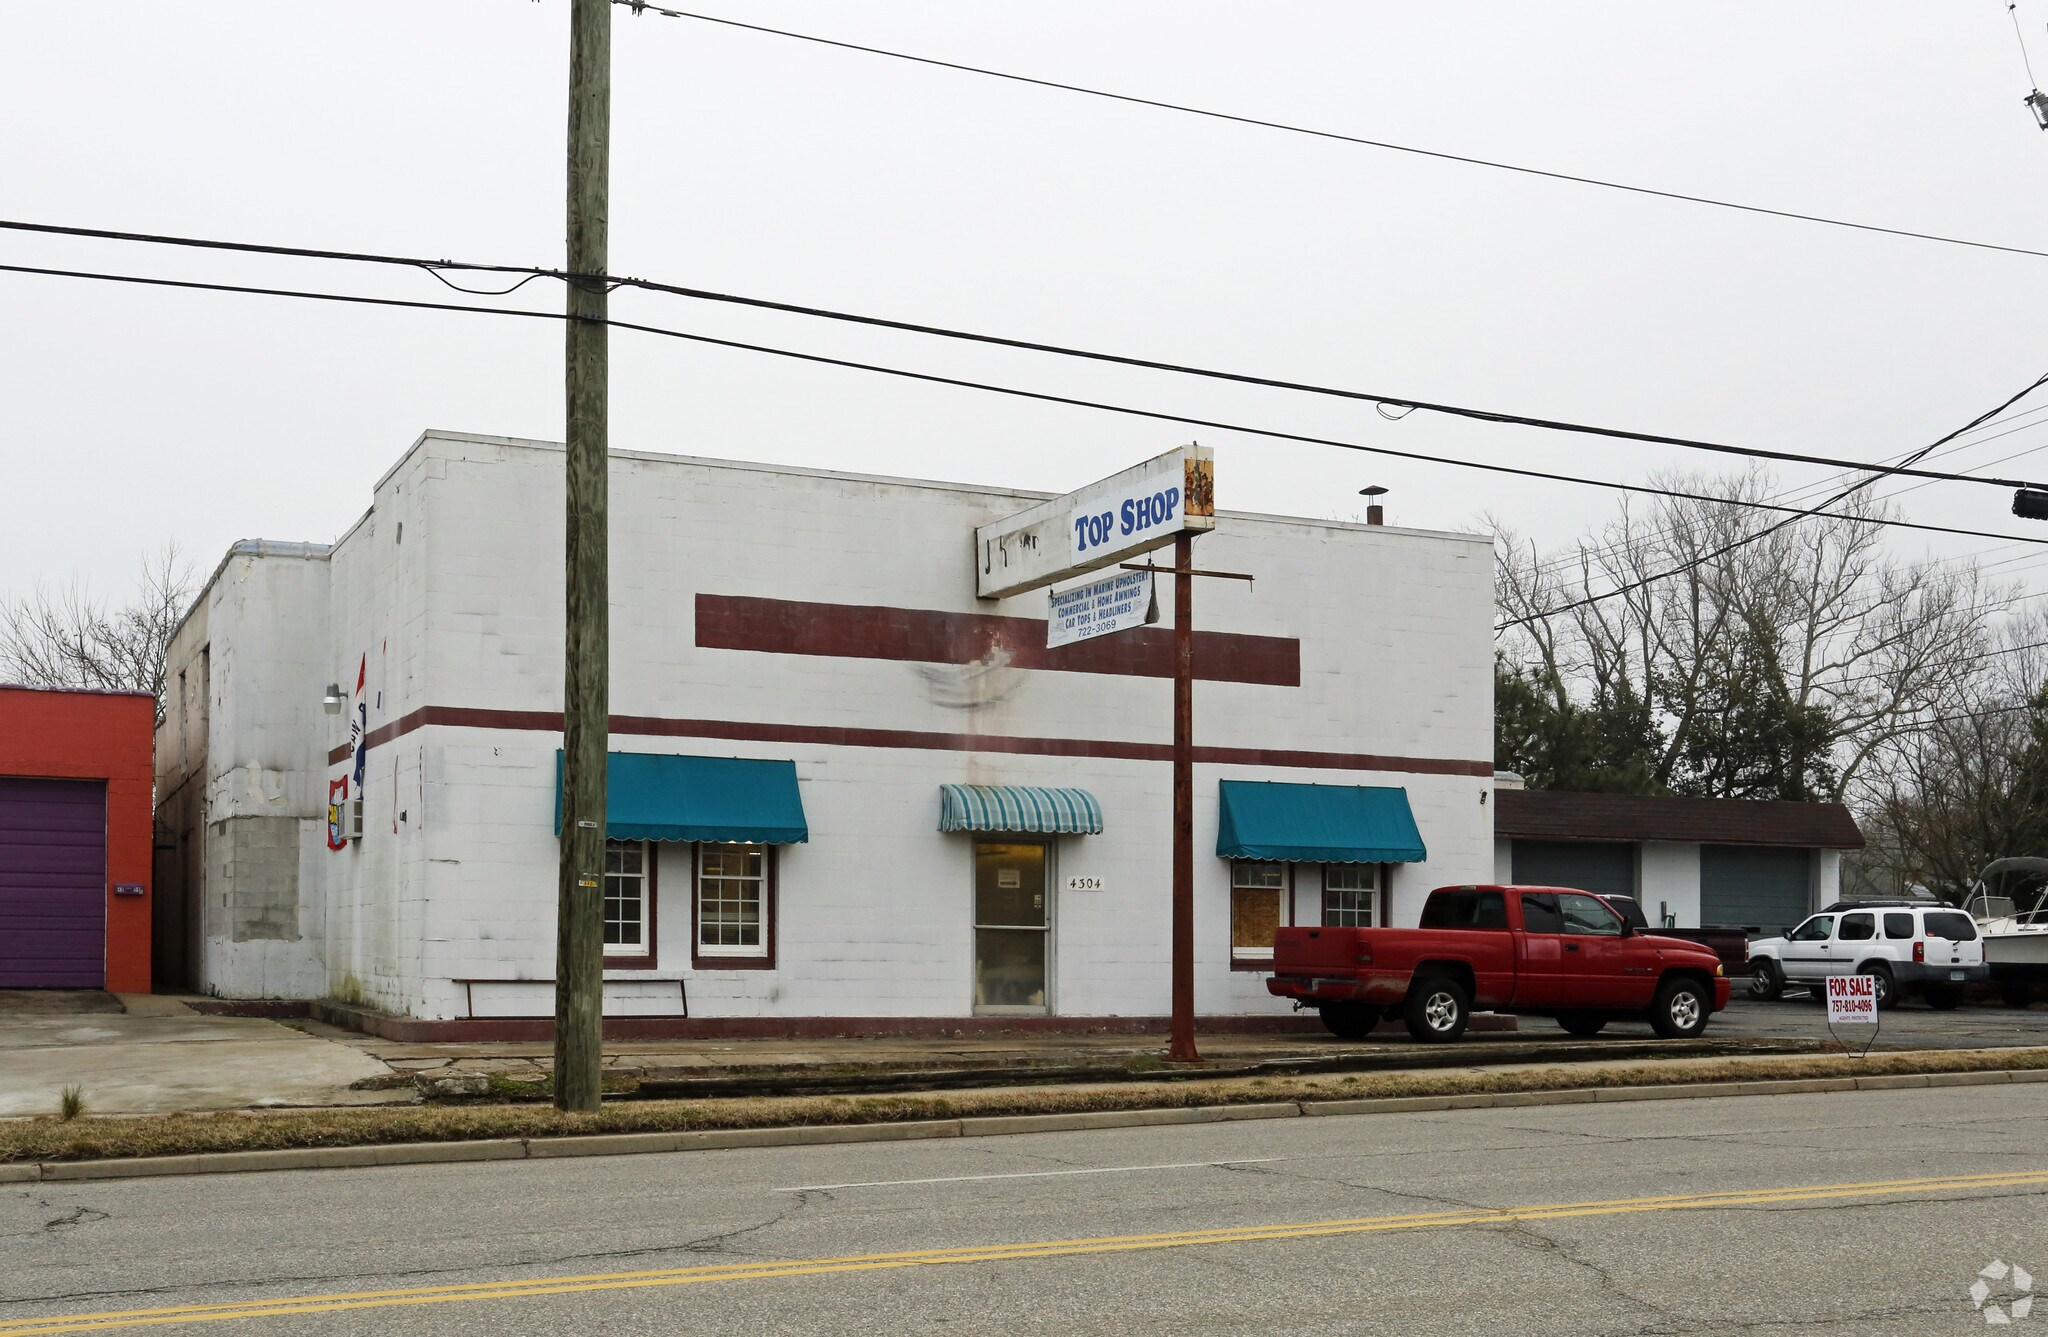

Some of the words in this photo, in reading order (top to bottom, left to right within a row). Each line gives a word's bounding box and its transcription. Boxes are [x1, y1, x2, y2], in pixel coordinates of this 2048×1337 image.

[1075, 510, 1113, 551] TOP
[1121, 487, 1179, 536] SHOP
[1051, 589, 1084, 608] SPECIALIZING
[1085, 587, 1092, 597] IN
[1093, 581, 1114, 595] MARINE
[1115, 571, 1149, 589] UPHOLSTERY
[1058, 602, 1089, 618] COMMERCIAL
[1097, 594, 1112, 607] HOME
[1114, 586, 1141, 602] AWNINGS
[1065, 618, 1075, 629] CAR
[1077, 613, 1091, 626] TOPS
[1098, 602, 1131, 620] HEADLINERS
[1078, 619, 1116, 637] 722-3069
[1070, 878, 1101, 889] 4304
[1829, 978, 1848, 996] FOR
[1849, 977, 1872, 996] SALE
[1832, 999, 1872, 1012] 757-810-4096
